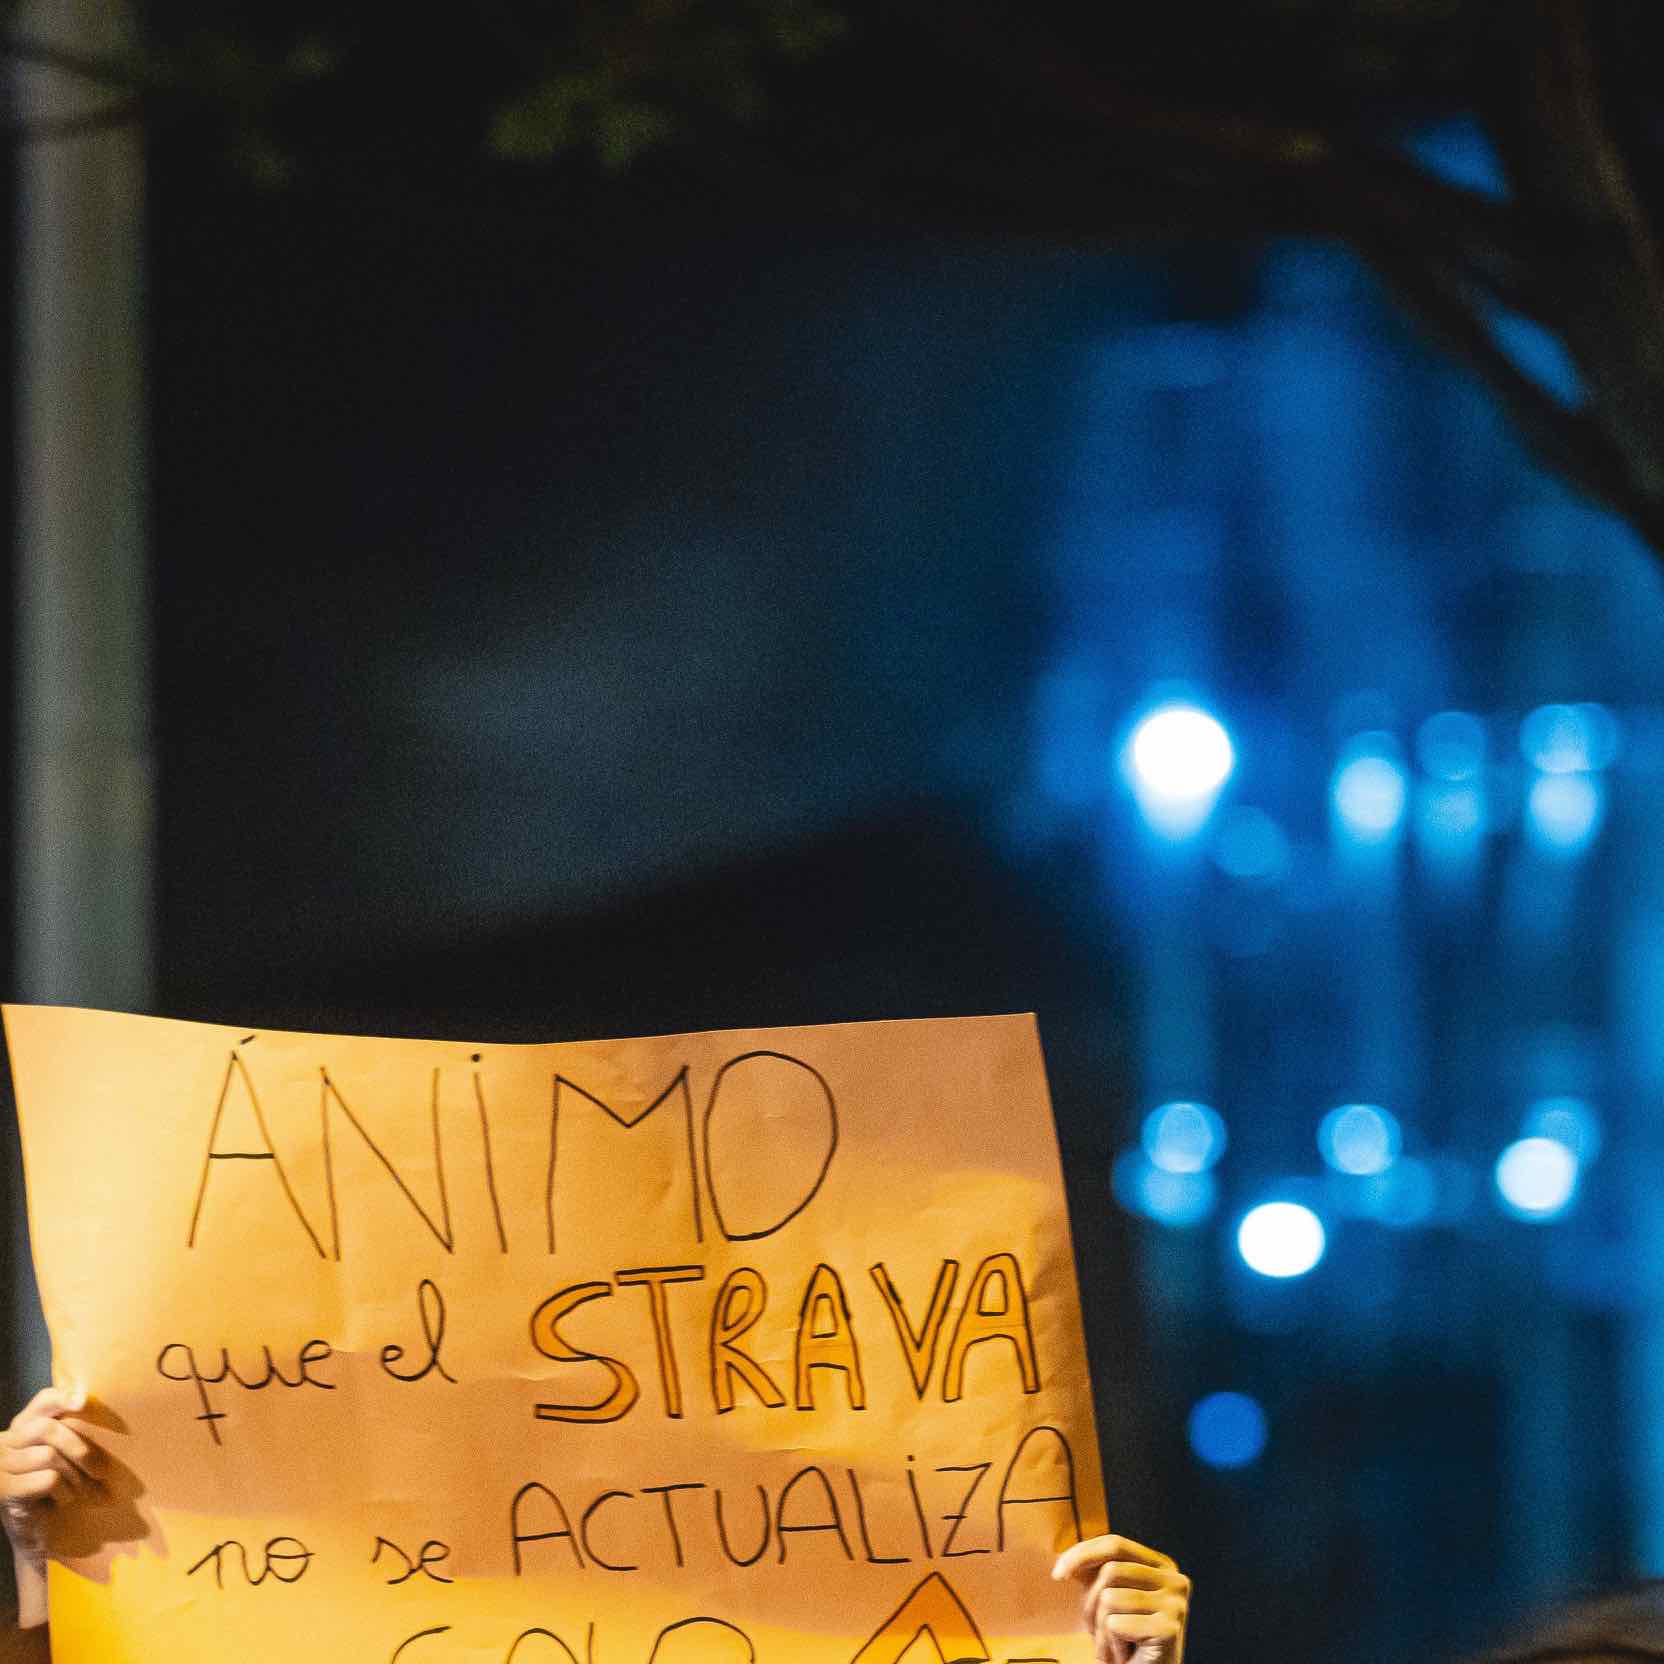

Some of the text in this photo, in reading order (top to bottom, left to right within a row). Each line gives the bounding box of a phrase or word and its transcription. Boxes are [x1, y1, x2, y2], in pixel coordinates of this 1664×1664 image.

[156, 1252, 1042, 1446] que el STRAVA
[186, 1536, 316, 1588] no
[370, 1536, 455, 1586] se
